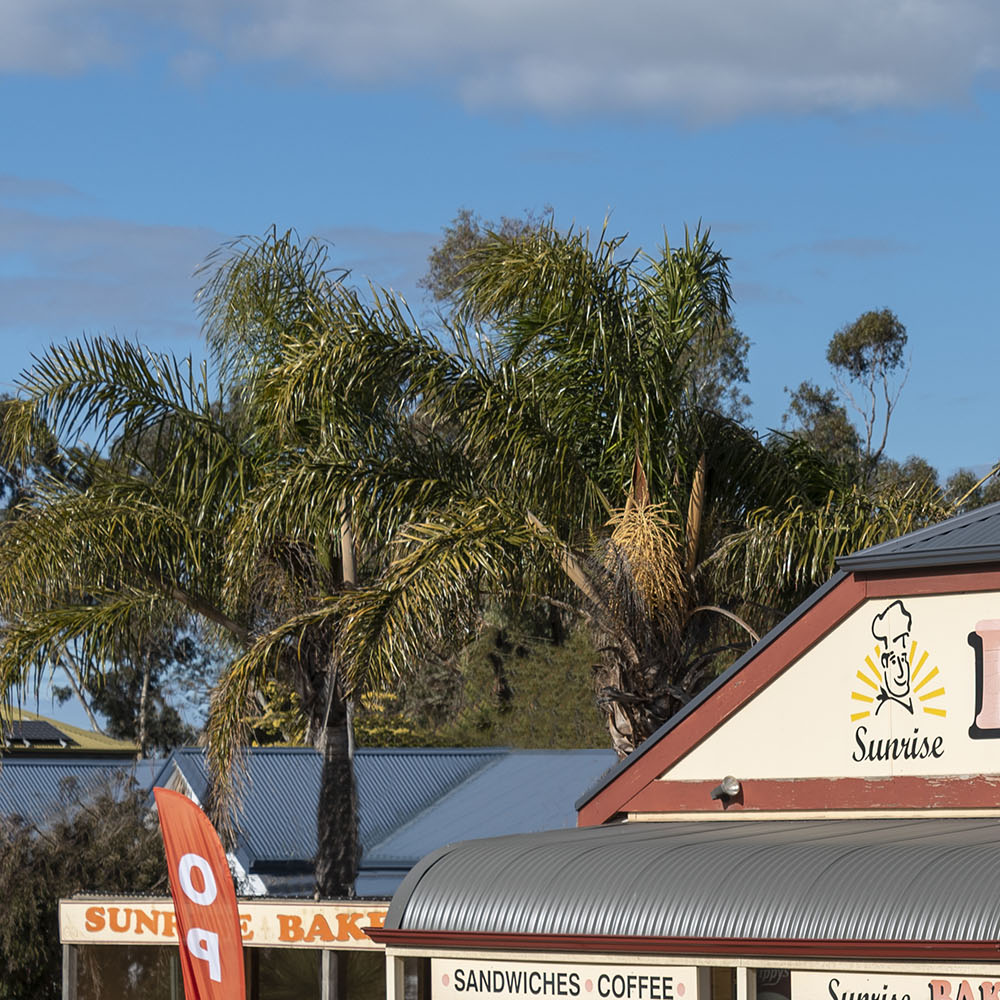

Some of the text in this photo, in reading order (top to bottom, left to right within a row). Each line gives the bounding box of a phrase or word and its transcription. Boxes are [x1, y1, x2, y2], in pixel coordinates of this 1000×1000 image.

[852, 725, 945, 762] Sunrise
[454, 969, 674, 1000] SANDWICHES COFFEE
